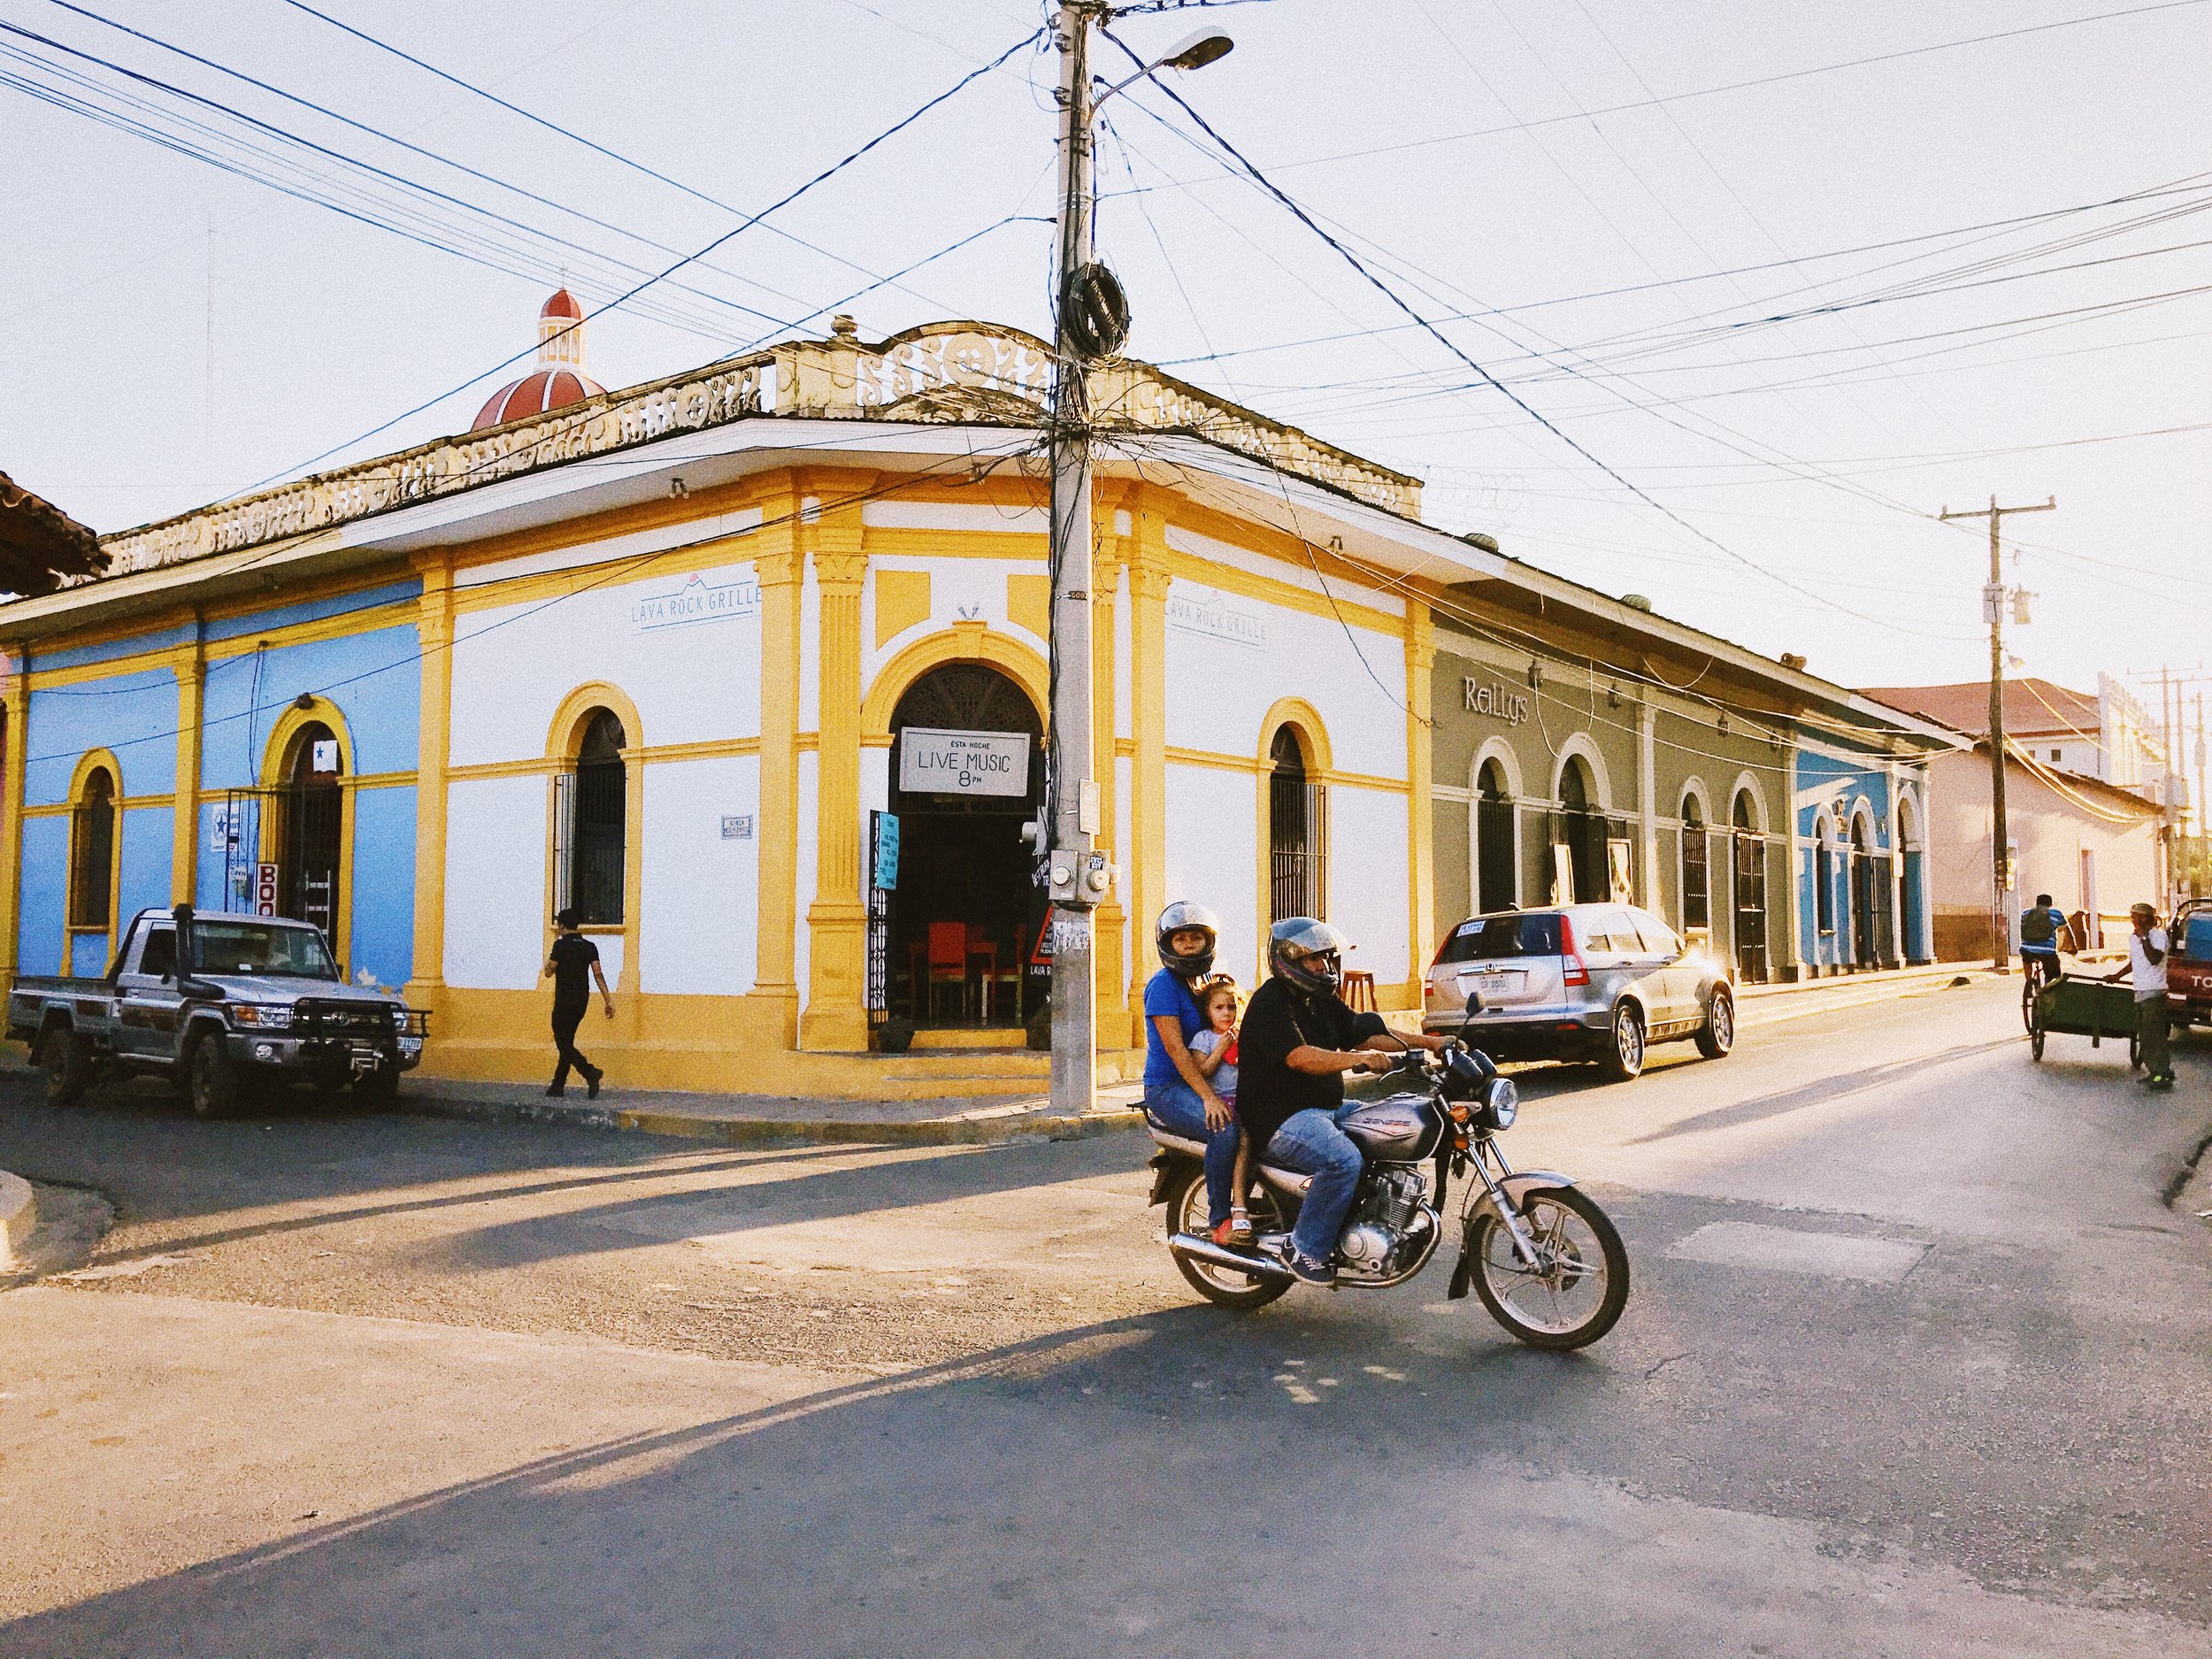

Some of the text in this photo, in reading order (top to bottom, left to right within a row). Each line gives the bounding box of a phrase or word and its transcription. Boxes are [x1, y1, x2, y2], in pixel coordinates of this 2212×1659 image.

[632, 586, 762, 623] LAVA ROCK GRILLE
[1165, 602, 1266, 640] AVA ROCK GRILLE
[918, 751, 1010, 773] LIVE MUSIC
[1030, 965, 1046, 975] LAVA
